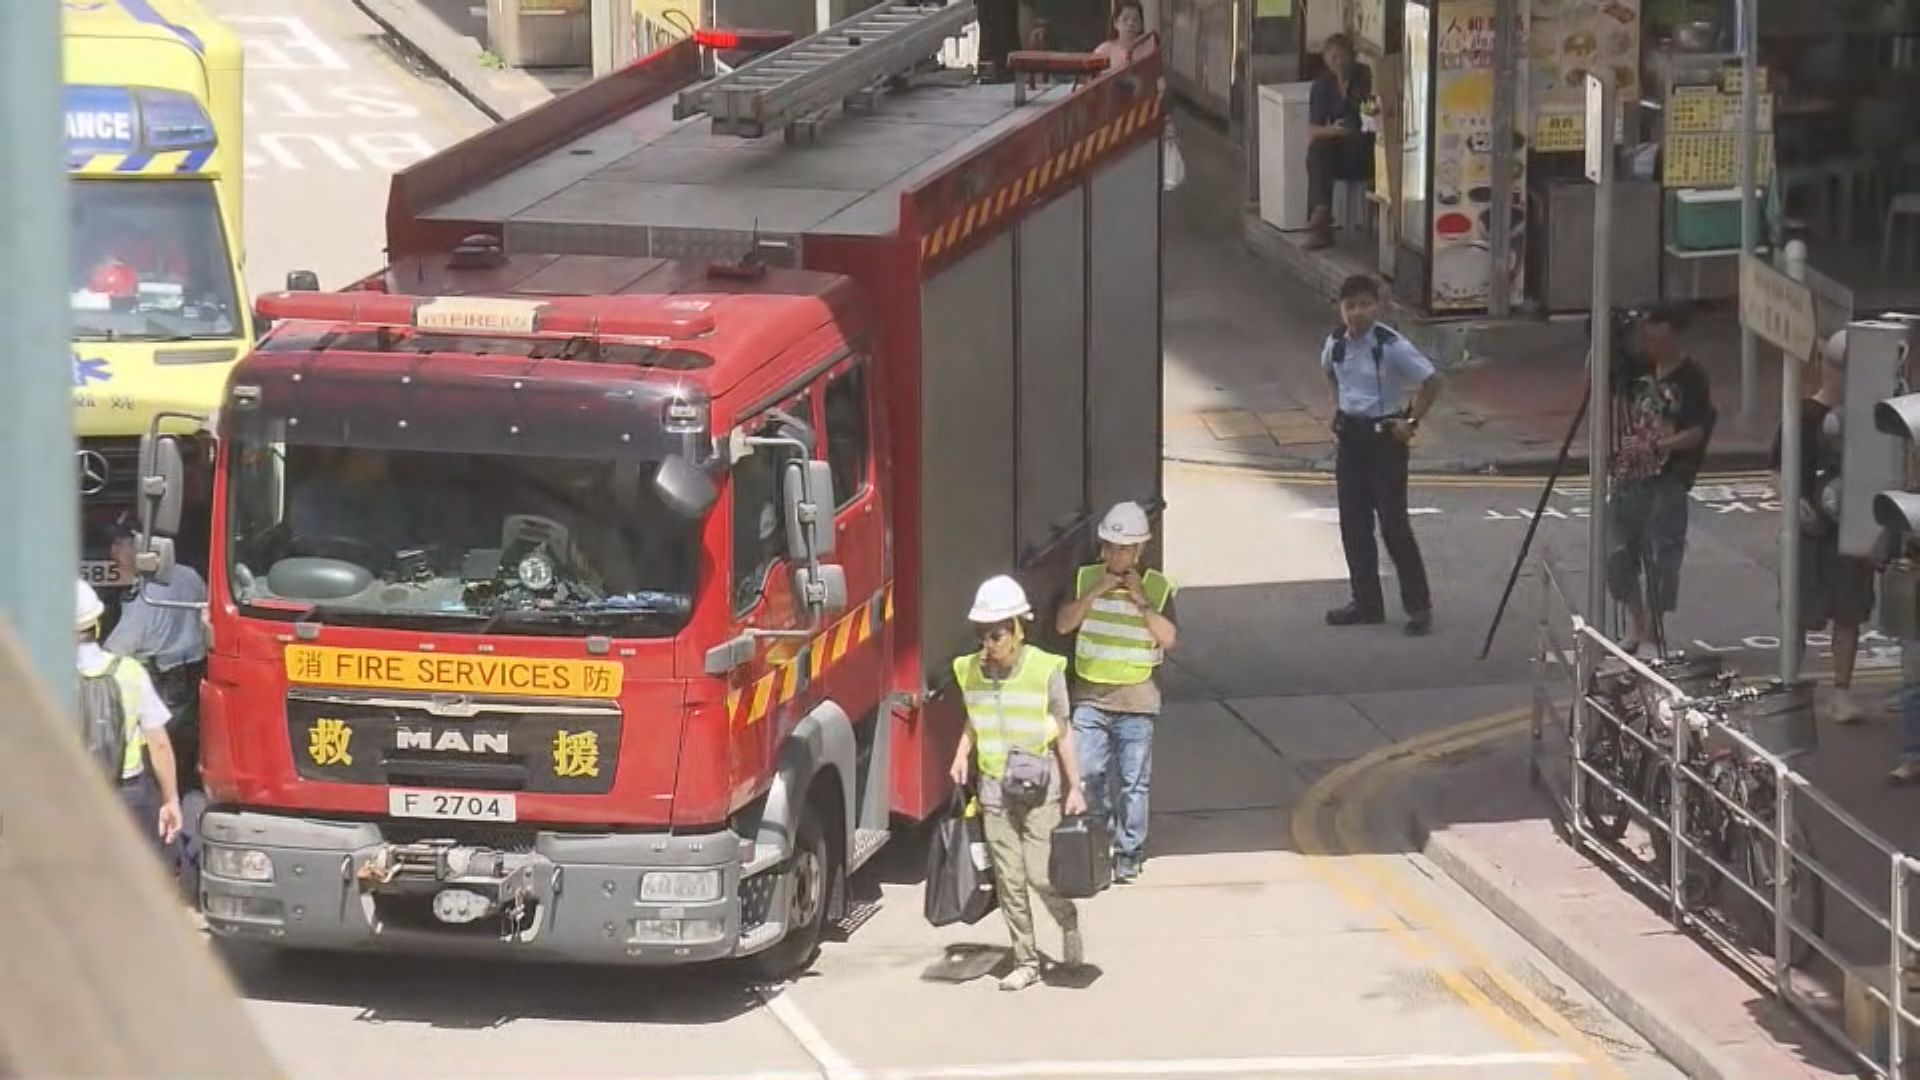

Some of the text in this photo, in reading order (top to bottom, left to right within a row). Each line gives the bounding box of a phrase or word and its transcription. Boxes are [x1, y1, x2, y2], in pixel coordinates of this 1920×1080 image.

[297, 649, 611, 692] 消 FIRE SERVICES 防
[308, 718, 353, 766] 救
[396, 727, 509, 754] MAN
[552, 729, 600, 777] 援
[404, 794, 501, 817] F 2704
